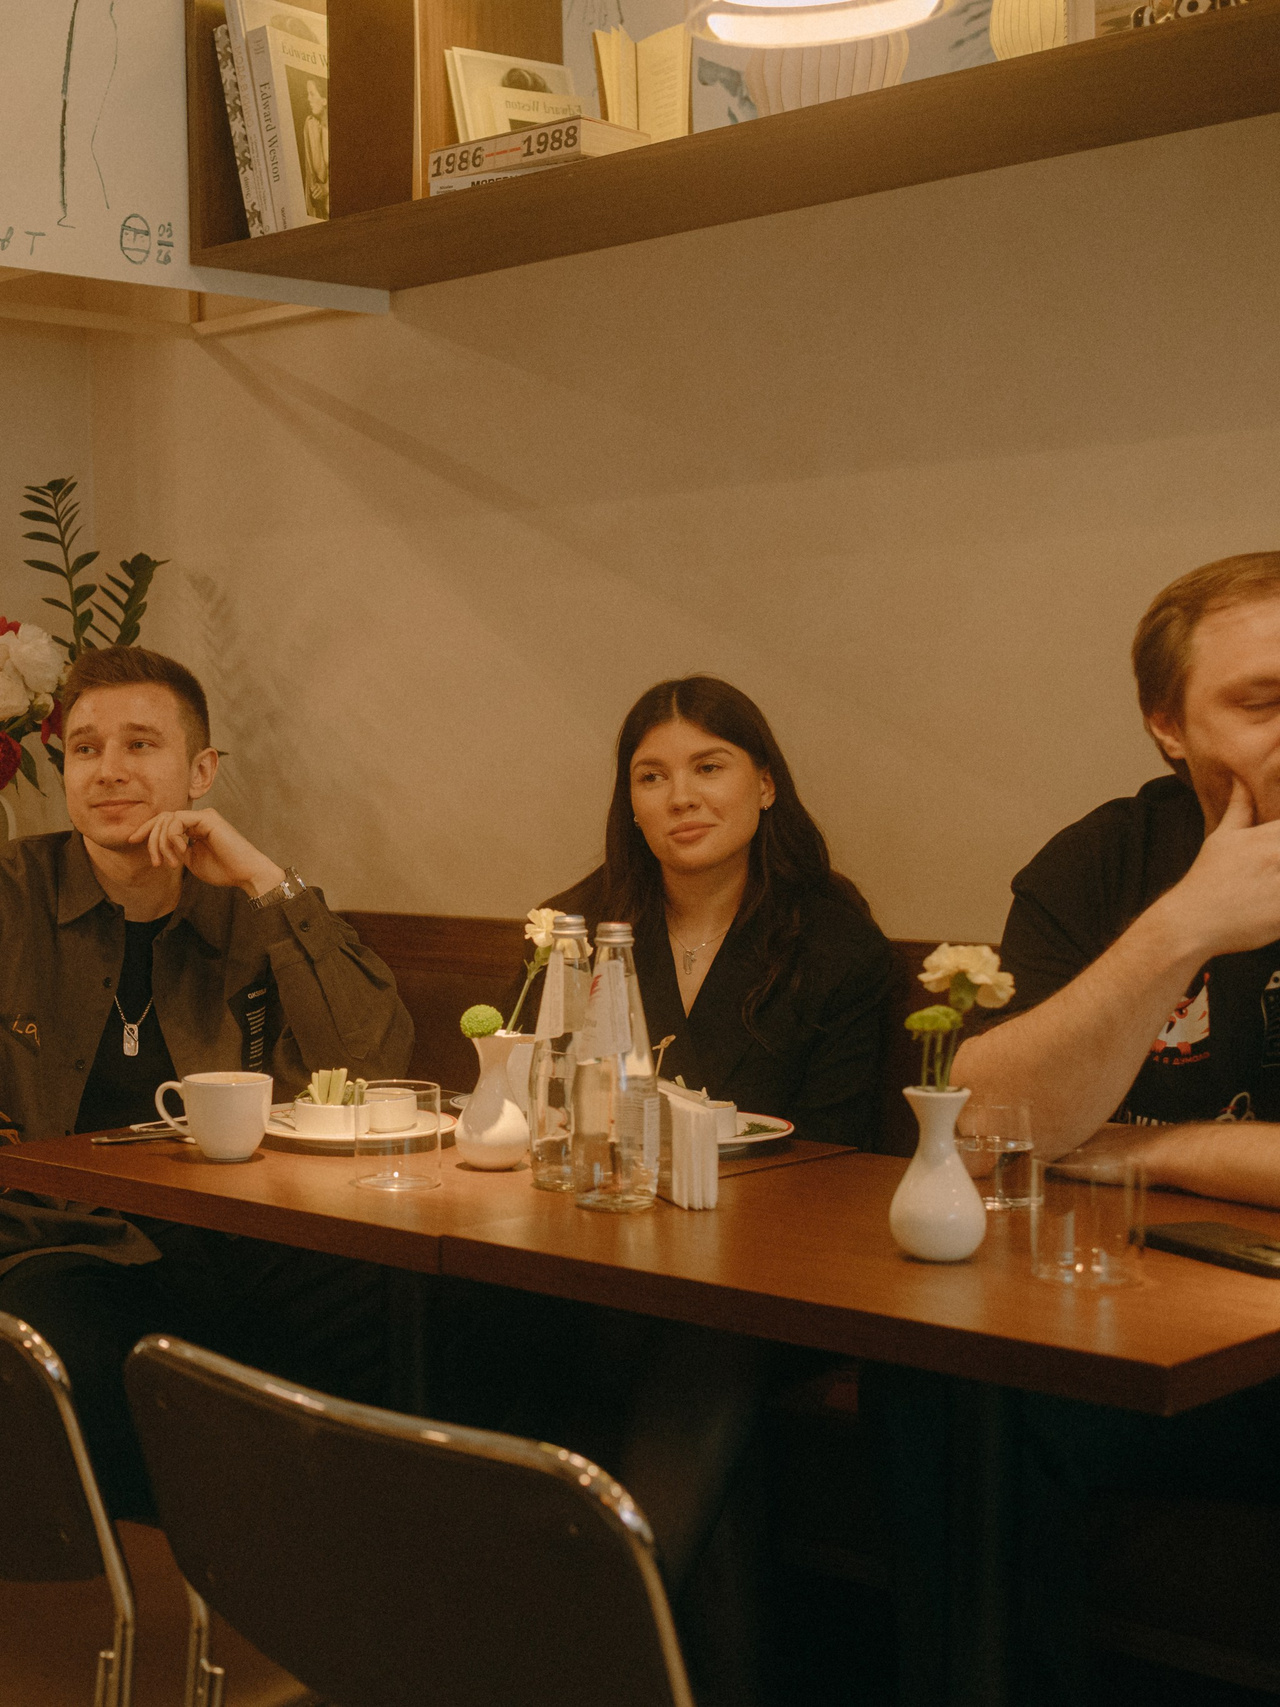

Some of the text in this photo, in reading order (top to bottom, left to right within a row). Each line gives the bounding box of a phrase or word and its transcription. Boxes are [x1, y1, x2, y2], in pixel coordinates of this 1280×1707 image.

[259, 82, 281, 183] Edward Weston
[431, 146, 484, 178] 1986
[521, 125, 578, 158] 1988
